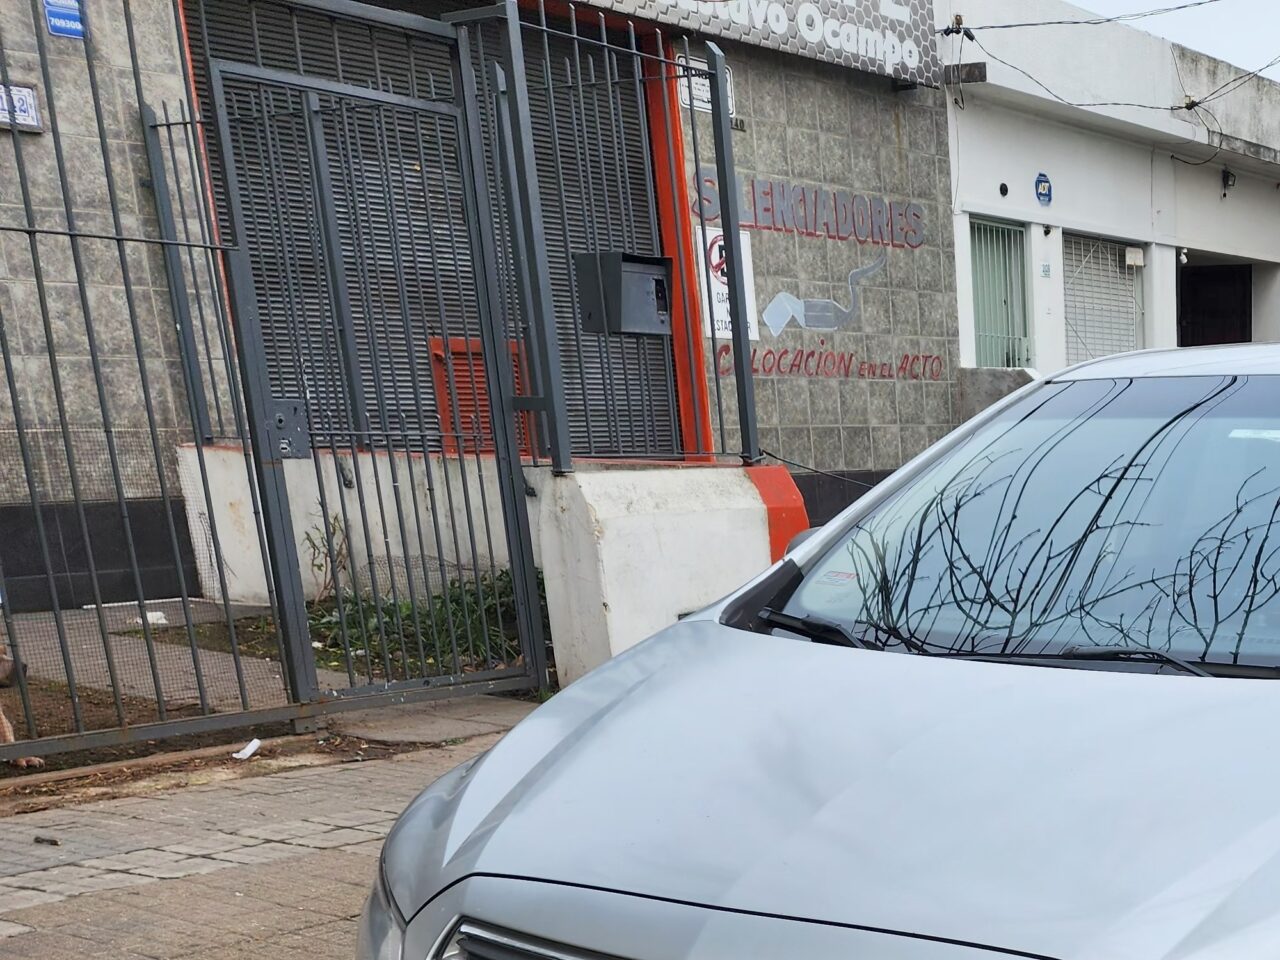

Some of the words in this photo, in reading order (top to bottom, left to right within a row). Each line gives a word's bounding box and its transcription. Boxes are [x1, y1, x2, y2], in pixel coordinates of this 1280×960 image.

[798, 2, 920, 75] Ocampo
[692, 167, 925, 249] SLENCIADORES
[898, 353, 943, 380] ACTO
